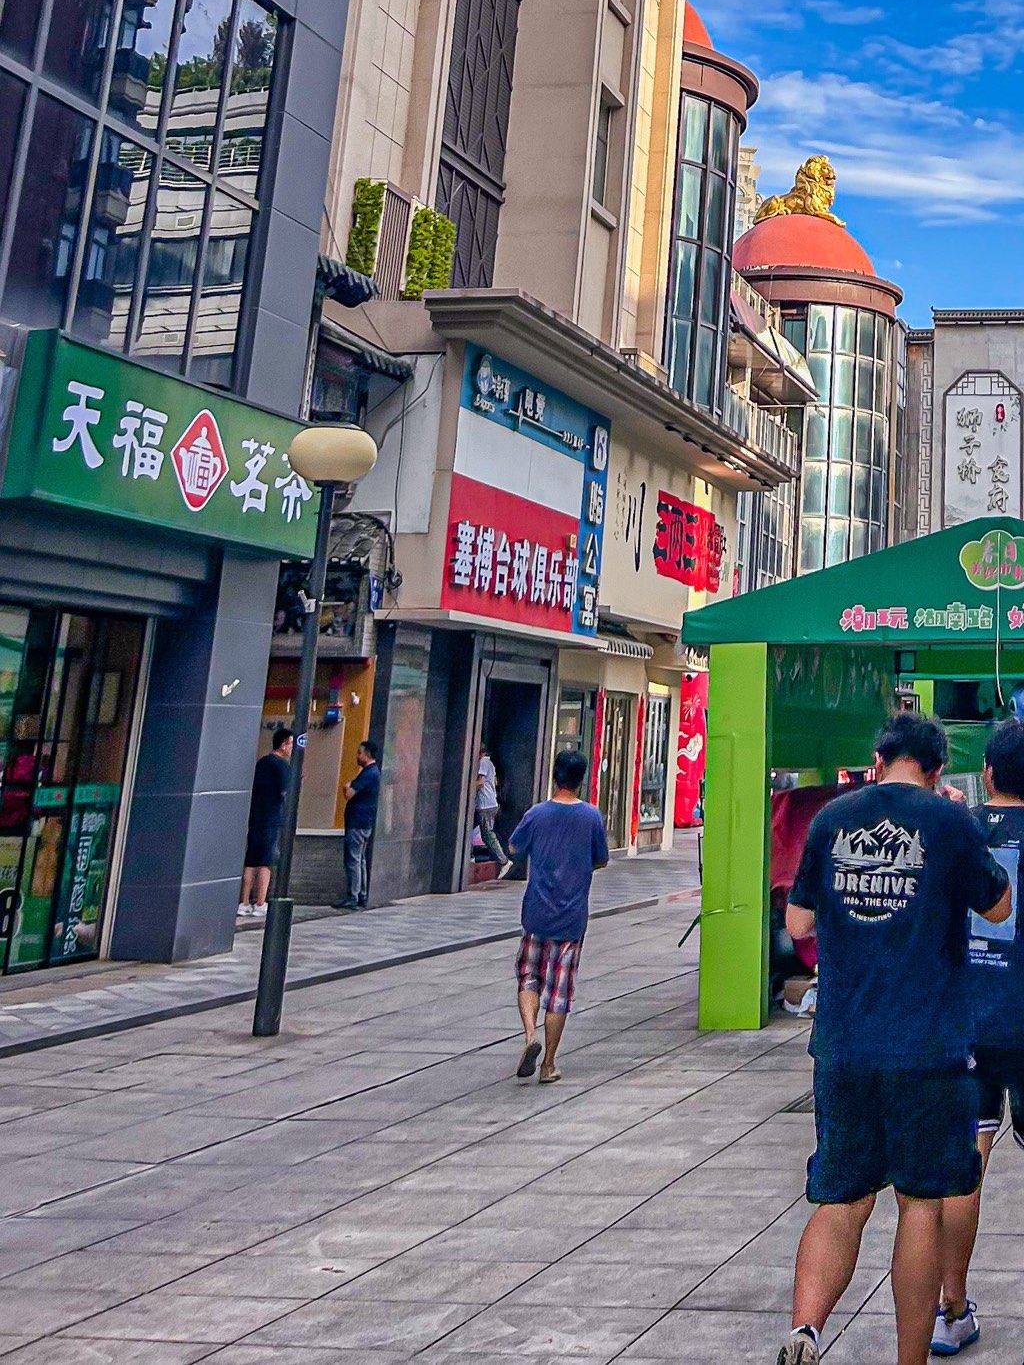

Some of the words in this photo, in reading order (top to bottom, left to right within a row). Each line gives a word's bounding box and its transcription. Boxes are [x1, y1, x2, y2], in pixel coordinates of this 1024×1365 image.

[53, 381, 168, 480] 天福
[839, 603, 909, 633] 潮玩
[914, 601, 993, 632] 湖南路
